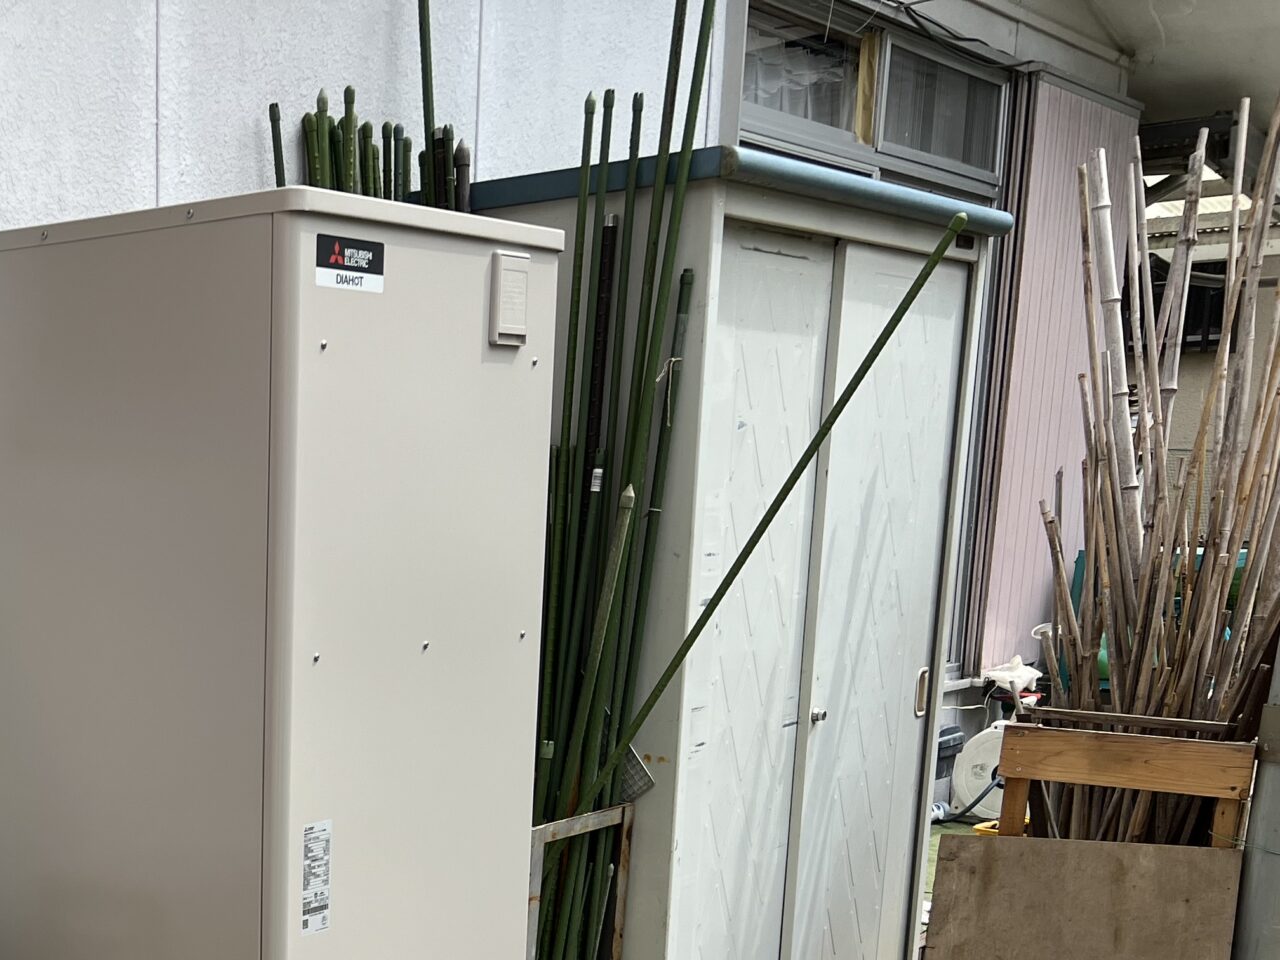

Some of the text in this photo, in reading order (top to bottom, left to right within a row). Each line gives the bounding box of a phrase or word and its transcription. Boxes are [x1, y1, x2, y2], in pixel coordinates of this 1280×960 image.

[344, 248, 373, 260] MITSUBISHI
[344, 256, 369, 268] ELECTRIC
[336, 273, 364, 287] DIAHOT
